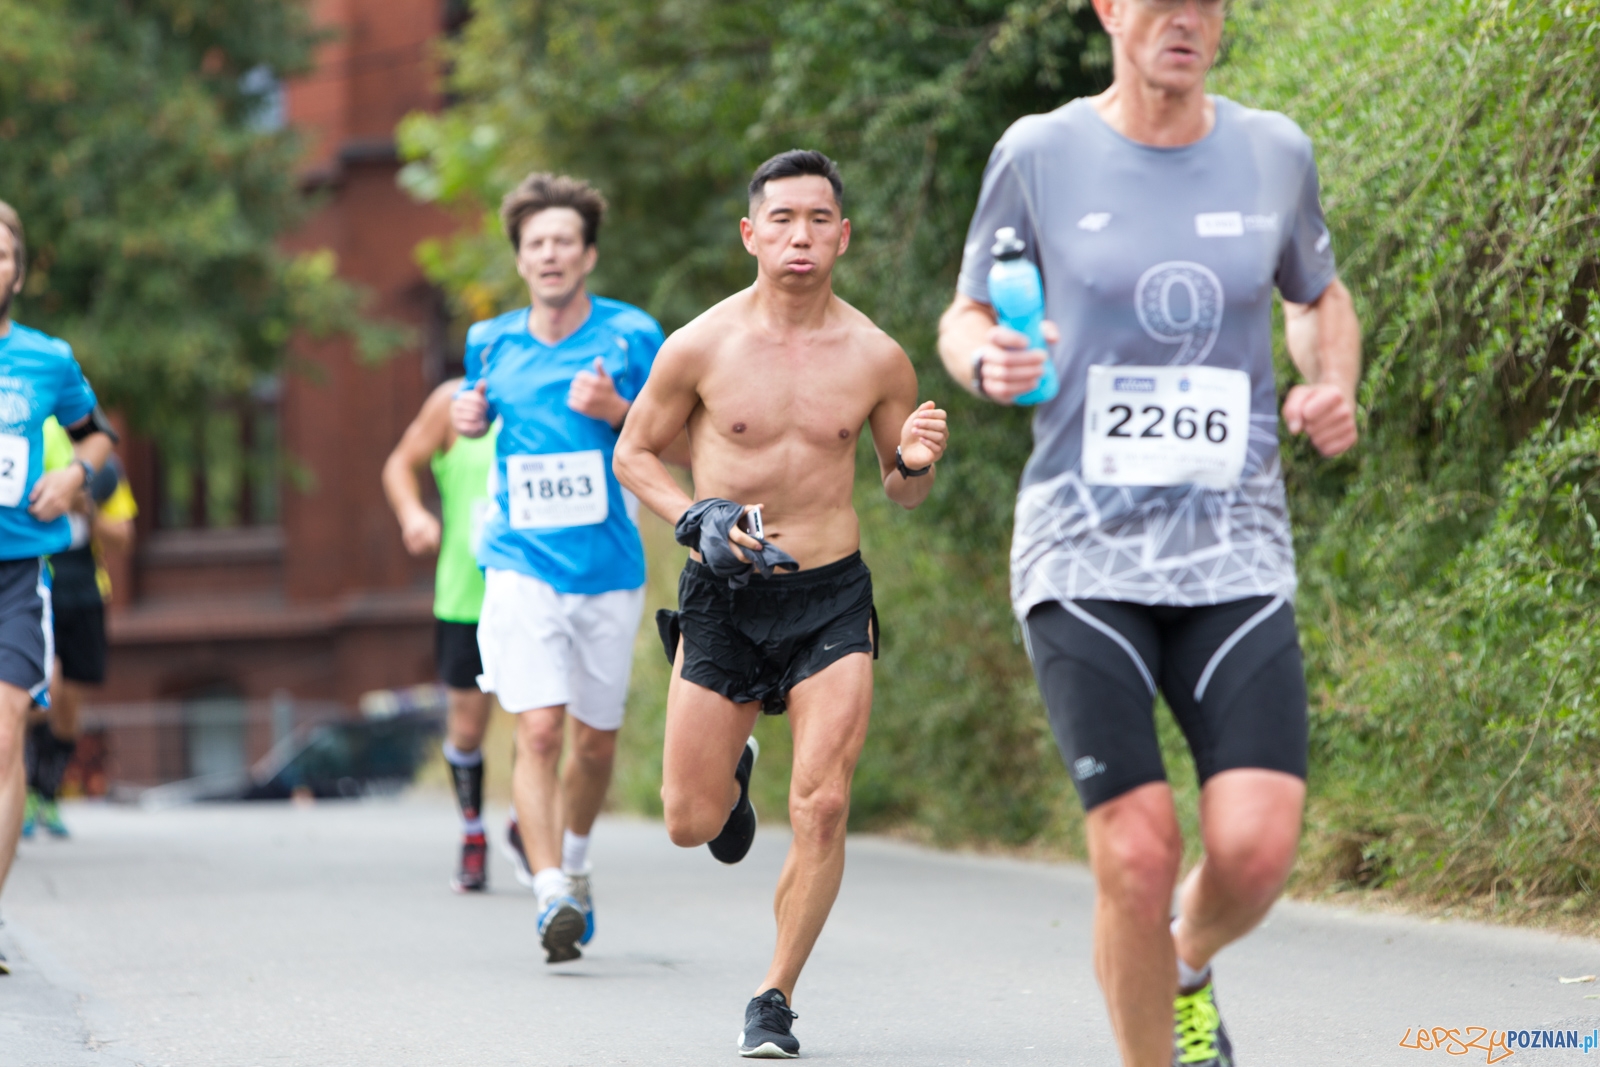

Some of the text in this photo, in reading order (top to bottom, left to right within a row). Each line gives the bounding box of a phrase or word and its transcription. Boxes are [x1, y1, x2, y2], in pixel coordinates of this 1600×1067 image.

[1136, 261, 1225, 366] 9
[1106, 404, 1228, 444] 2266
[523, 475, 593, 499] 1863
